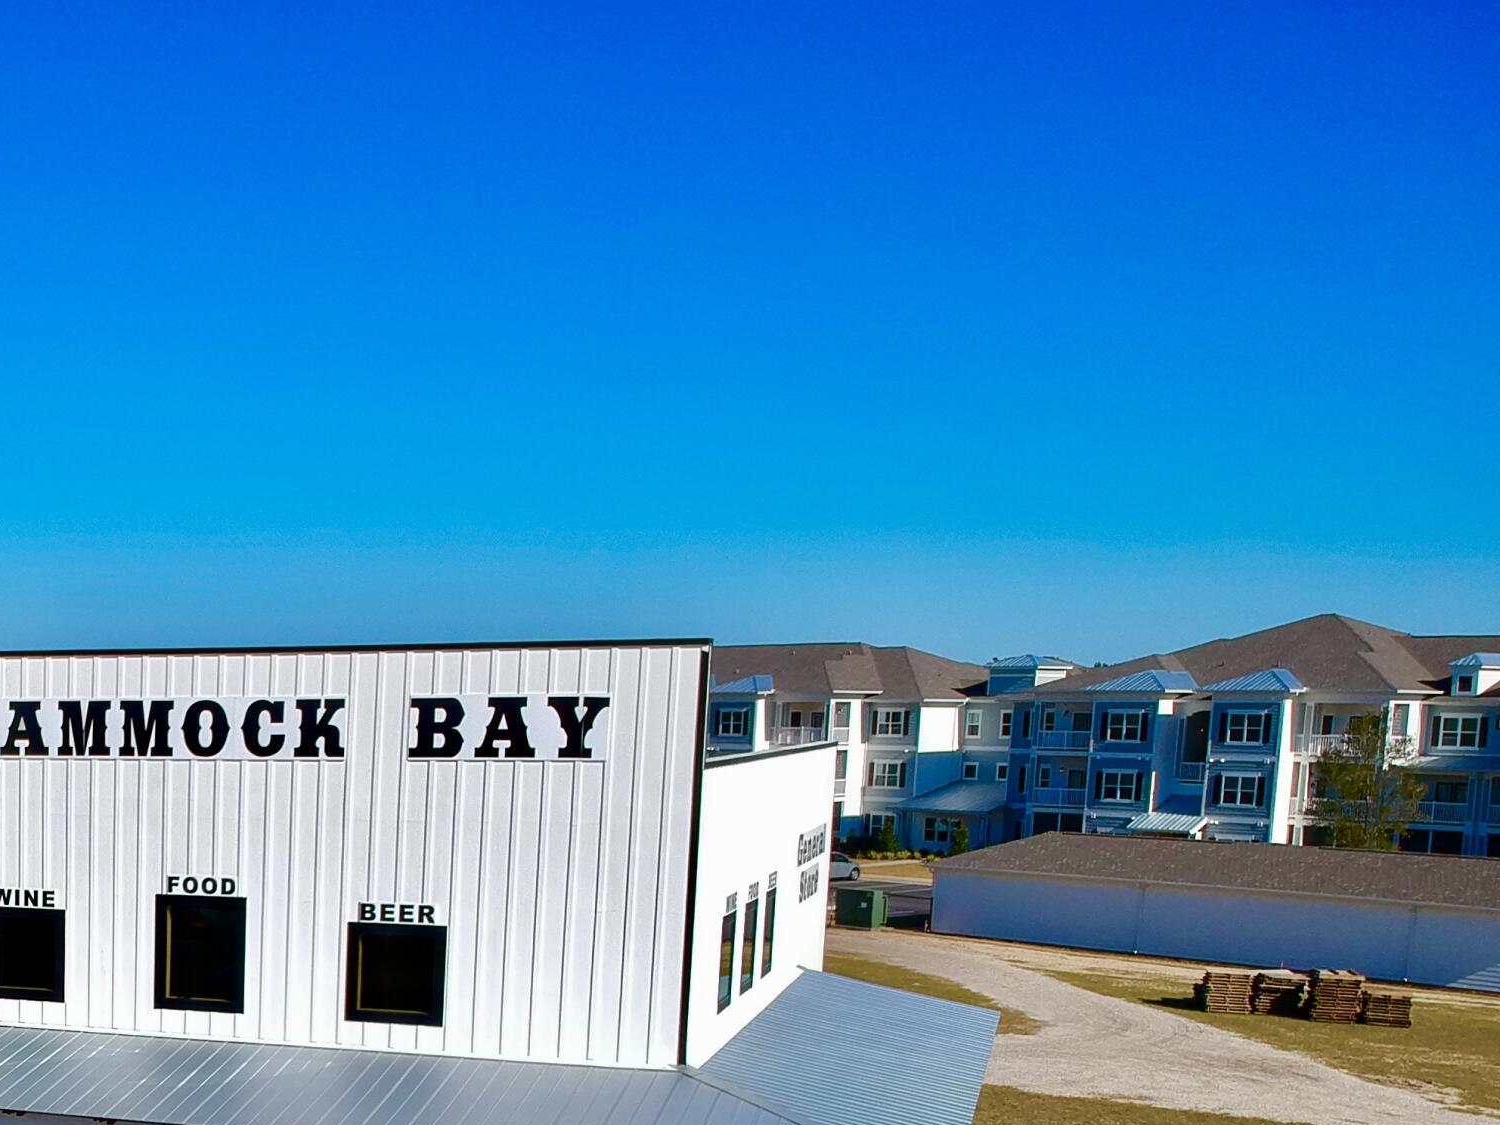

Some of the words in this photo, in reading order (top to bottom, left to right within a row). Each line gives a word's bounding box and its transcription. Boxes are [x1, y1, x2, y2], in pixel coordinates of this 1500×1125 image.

[407, 696, 611, 759] BAY
[798, 823, 827, 867] General
[167, 877, 236, 894] FOOD
[799, 869, 819, 904] Store
[359, 902, 435, 923] BEER
